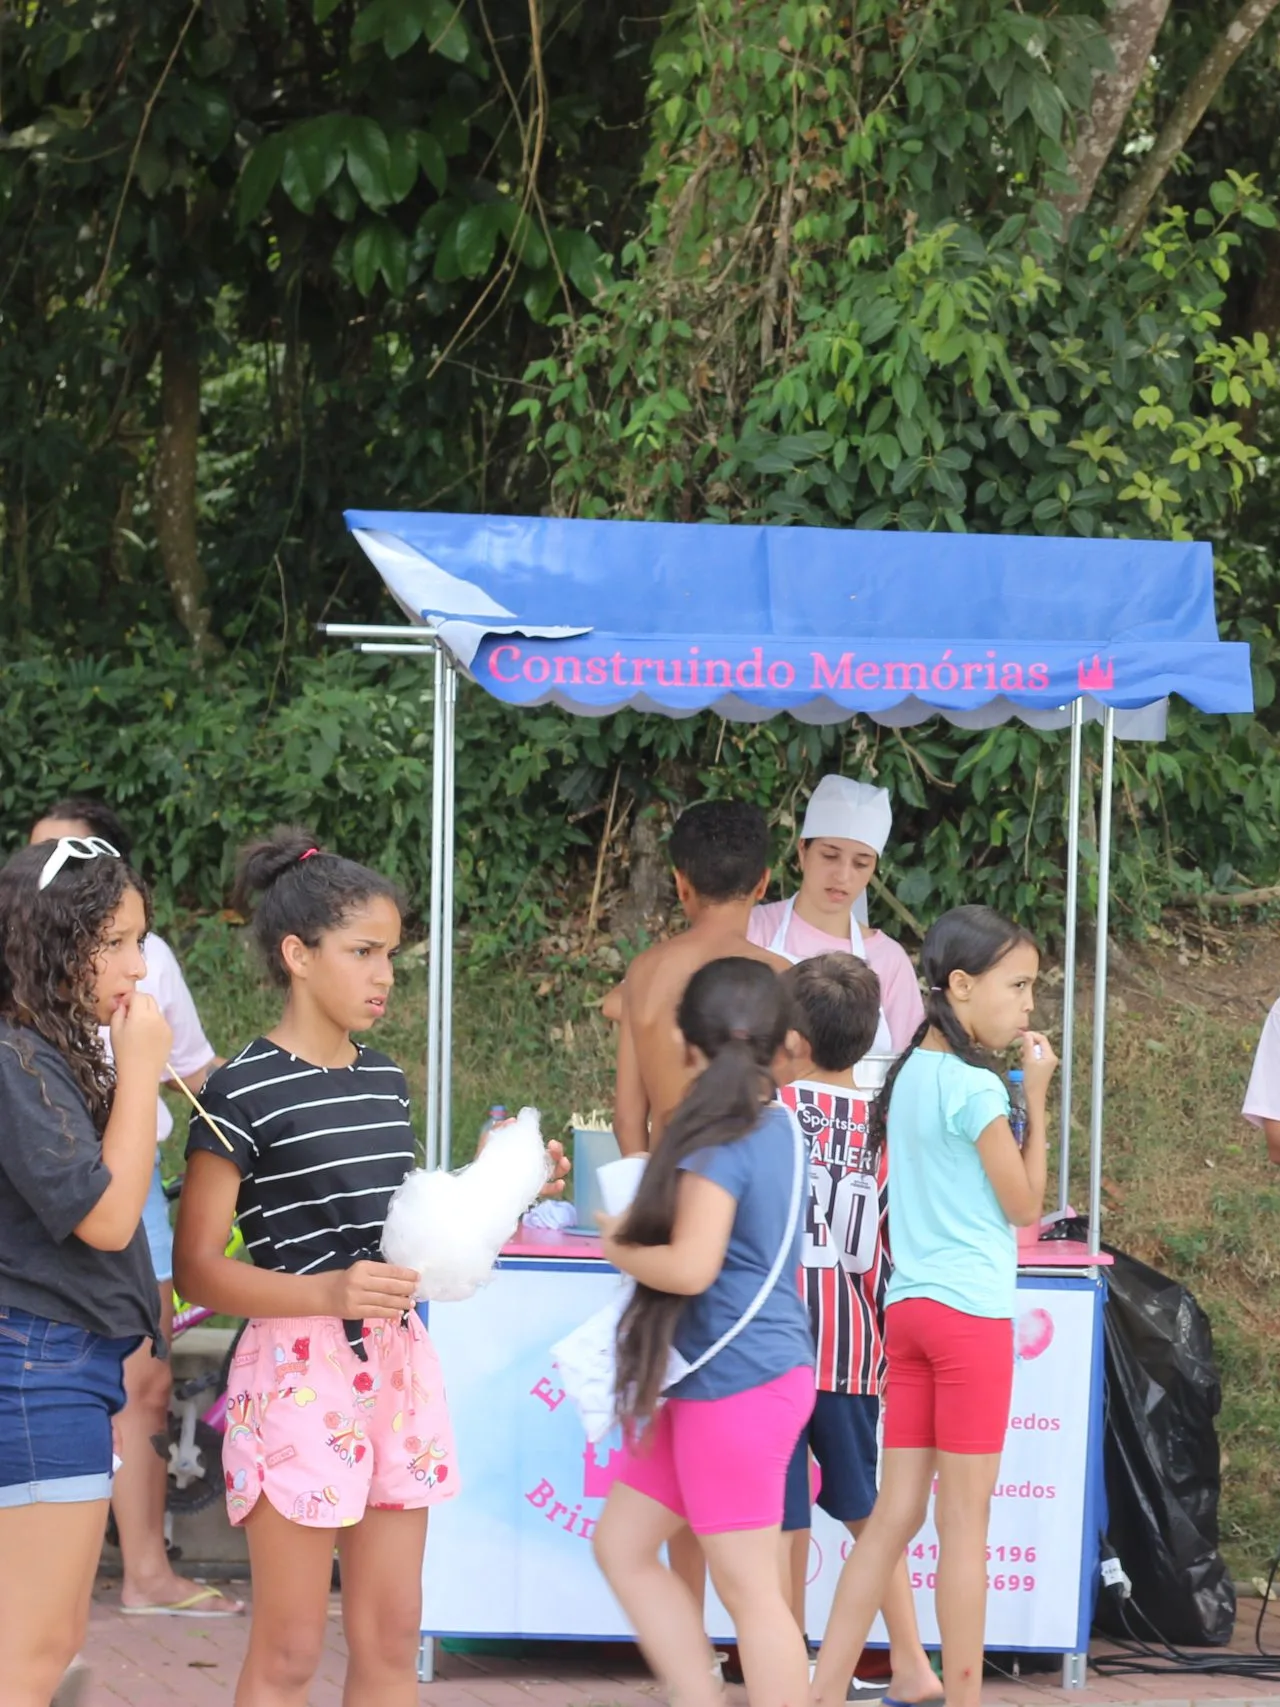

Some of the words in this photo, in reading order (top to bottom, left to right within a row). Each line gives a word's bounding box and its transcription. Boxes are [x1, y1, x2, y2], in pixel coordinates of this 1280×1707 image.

[488, 645, 796, 690] Construindo
[809, 649, 1050, 691] Memórias
[1005, 1413, 1061, 1431] edos
